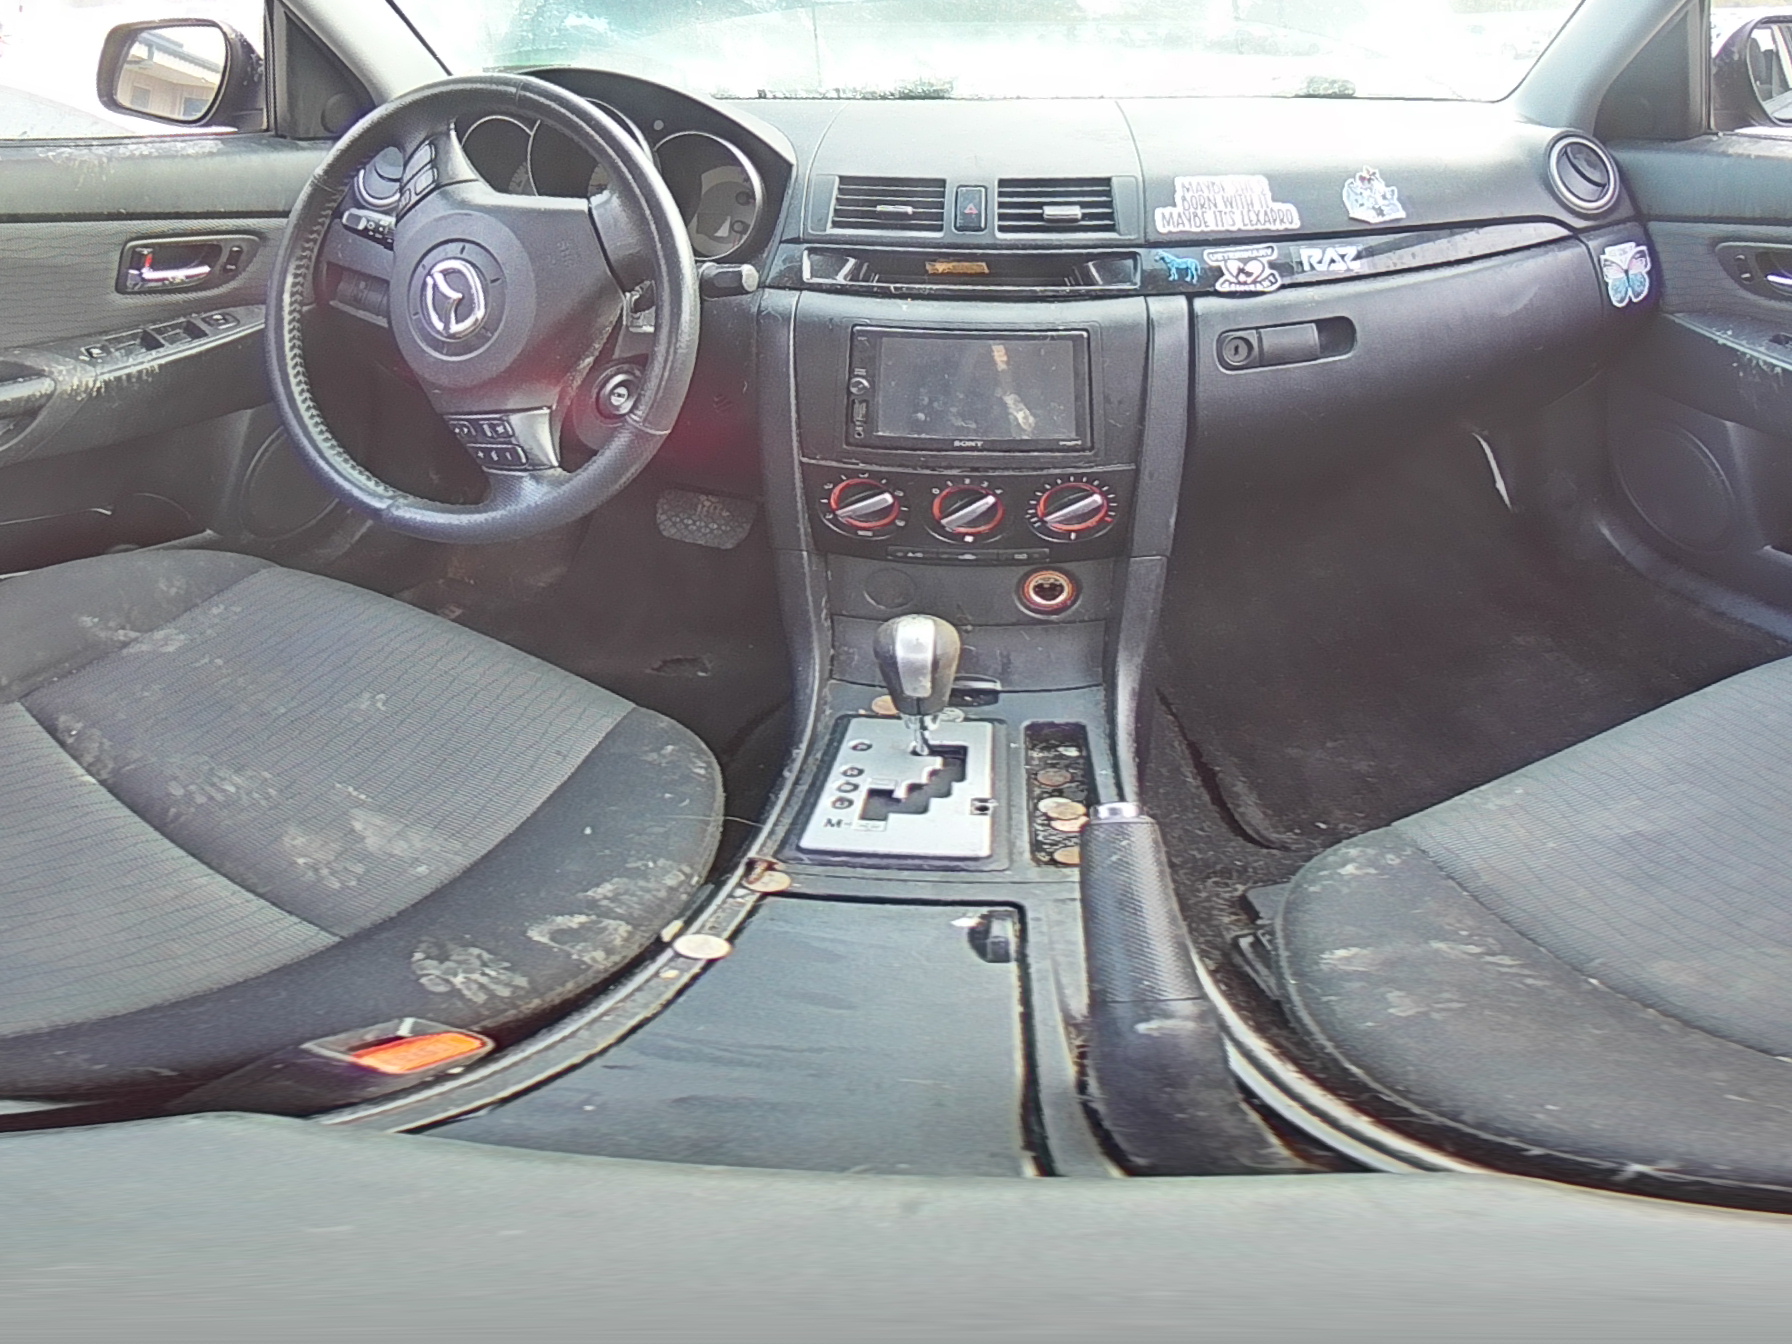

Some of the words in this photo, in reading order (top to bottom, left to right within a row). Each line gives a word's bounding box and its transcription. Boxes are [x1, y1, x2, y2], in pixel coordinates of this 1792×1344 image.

[1181, 194, 1218, 211] BORN
[1222, 193, 1254, 210] WITH
[1259, 192, 1270, 209] IT
[1161, 209, 1210, 229] MAYBE
[953, 440, 984, 448] SONY
[825, 818, 843, 828] M
